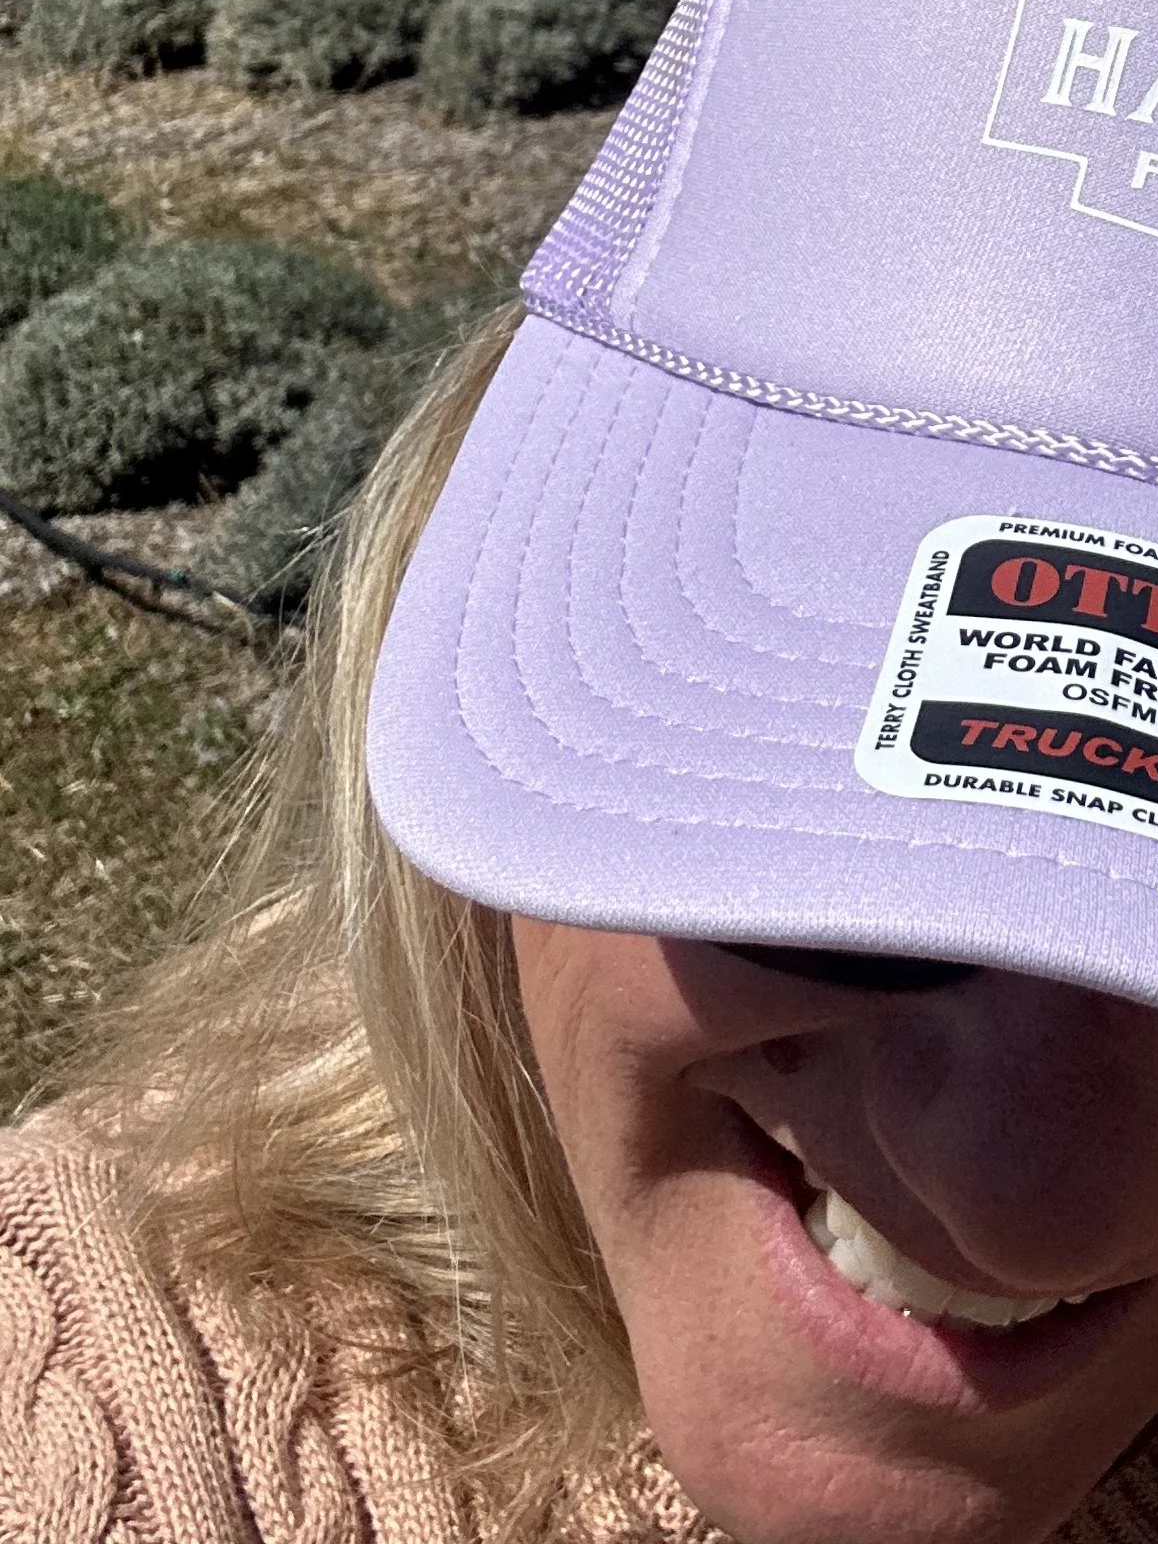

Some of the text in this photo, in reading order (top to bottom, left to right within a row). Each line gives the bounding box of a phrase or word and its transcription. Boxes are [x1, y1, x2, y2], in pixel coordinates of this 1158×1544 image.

[998, 521, 1106, 548] PREMIUM
[875, 549, 951, 751] TERRY CLOTH SWEATBAND
[958, 628, 1101, 658] WORLD
[982, 652, 1098, 680] FOAM
[1061, 682, 1157, 726] OSFM
[923, 772, 1043, 799] DURABLE
[1050, 787, 1124, 815] SNAP
